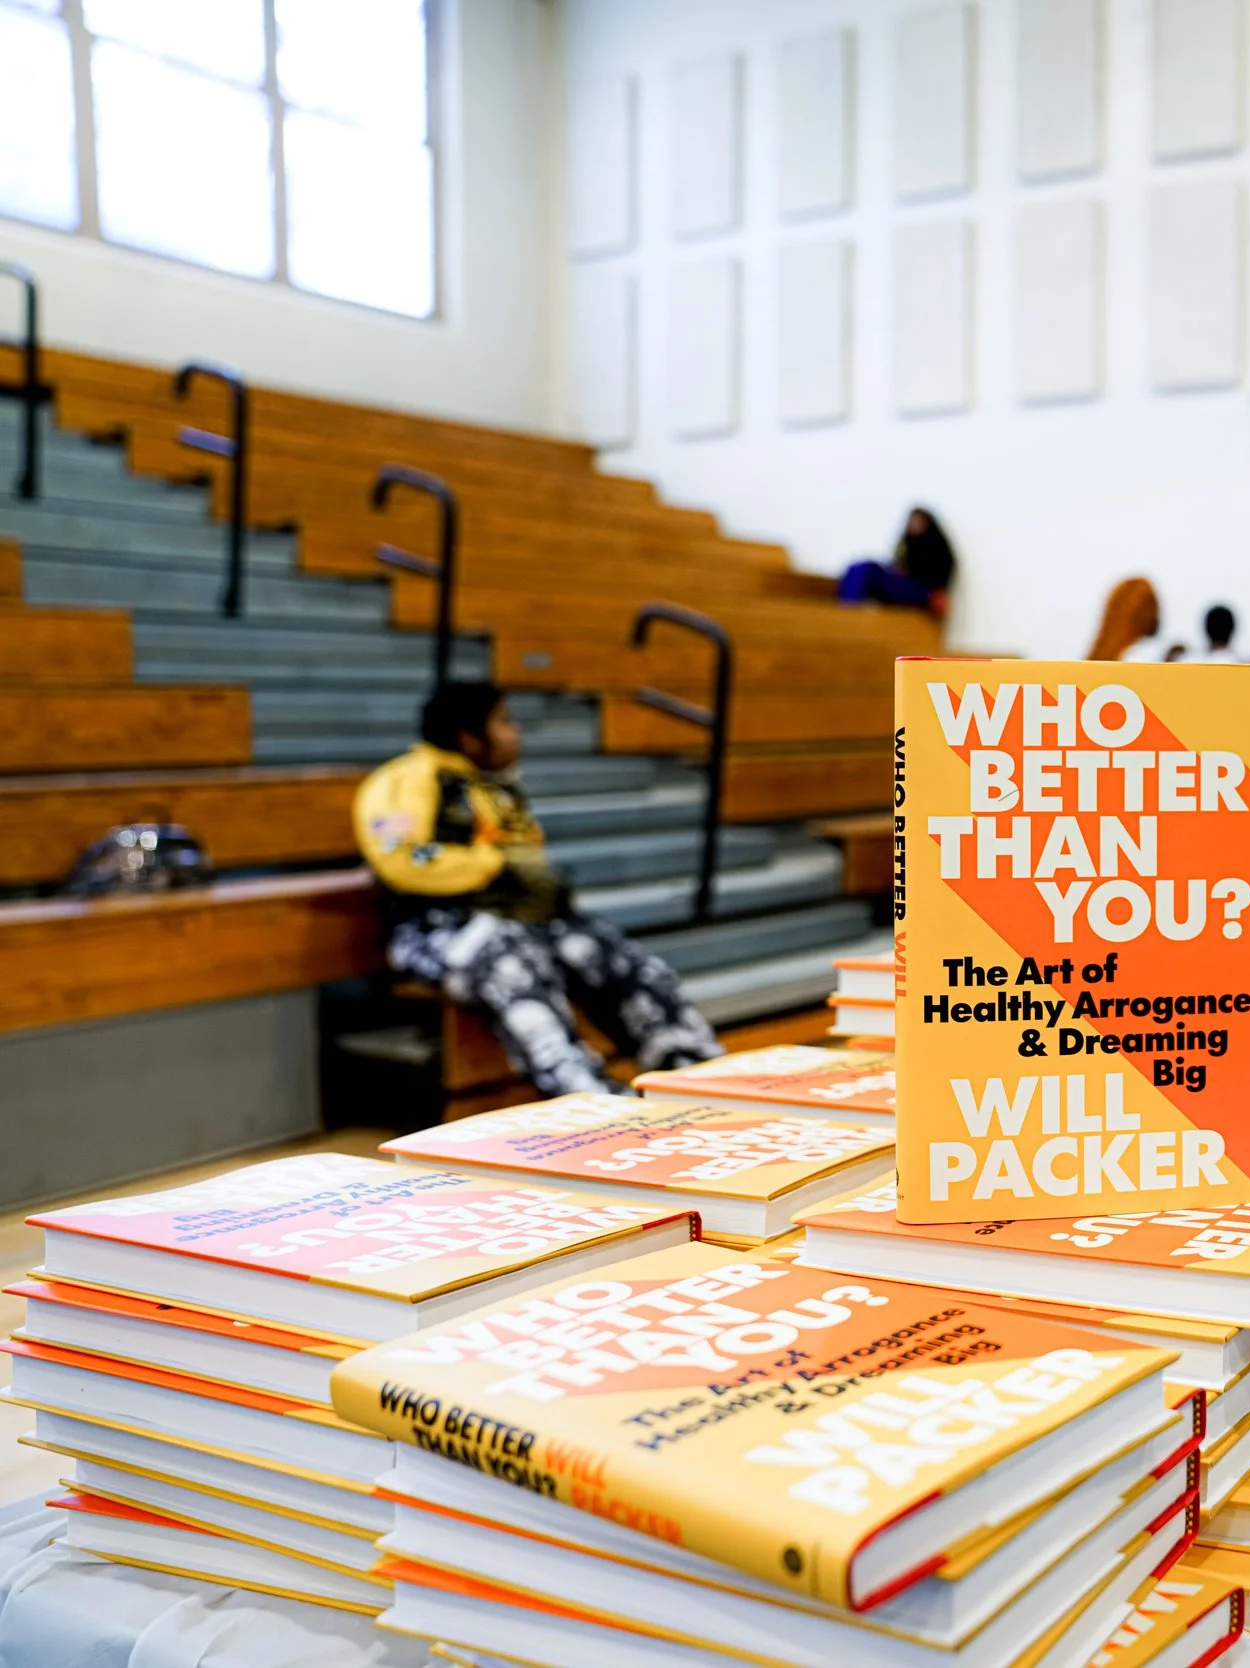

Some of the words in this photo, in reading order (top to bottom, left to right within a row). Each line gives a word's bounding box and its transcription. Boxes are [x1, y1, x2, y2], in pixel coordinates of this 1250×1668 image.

[927, 683, 1145, 747] WHO
[970, 750, 1249, 812] BETTER
[928, 816, 1158, 879] THAN
[942, 957, 1008, 987] The
[1015, 958, 1074, 985] Art
[1081, 953, 1118, 983] of
[923, 990, 1066, 1028] Healthy
[1018, 1029, 1048, 1057] &
[1059, 1022, 1228, 1057] Dreaming
[950, 1072, 1141, 1138] WILL
[1153, 1059, 1207, 1093] Big
[585, 1130, 733, 1170] YOU?
[929, 1129, 1229, 1202] PACKER
[173, 1192, 338, 1232] Dreaming
[173, 1208, 235, 1224] Big
[175, 1198, 345, 1243] Arrogance
[329, 1204, 361, 1218] of
[367, 1190, 414, 1206] Art
[382, 1190, 576, 1249] THAN
[239, 1203, 447, 1258] YOU?
[324, 1201, 580, 1275] BETTER
[478, 1205, 669, 1257] WHO
[381, 1281, 632, 1365] WHO
[484, 1263, 790, 1369] BETTER
[650, 1284, 889, 1374] YOU?
[484, 1302, 762, 1399] THAN
[636, 1380, 796, 1453] Healthy
[796, 1308, 966, 1381] Arrogance
[774, 1400, 815, 1418] &
[812, 1324, 986, 1398] Dreaming
[931, 1341, 1002, 1366] Big
[623, 1396, 704, 1428] The
[708, 1367, 769, 1397] Art
[774, 1349, 811, 1370] of
[380, 1380, 441, 1426] WHO
[444, 1406, 536, 1462] BETTER
[545, 1438, 608, 1489] WILL
[744, 1375, 984, 1469] WILL
[788, 1348, 1126, 1516] PACKER
[412, 1424, 484, 1474] THAN
[486, 1452, 558, 1500] YOU?
